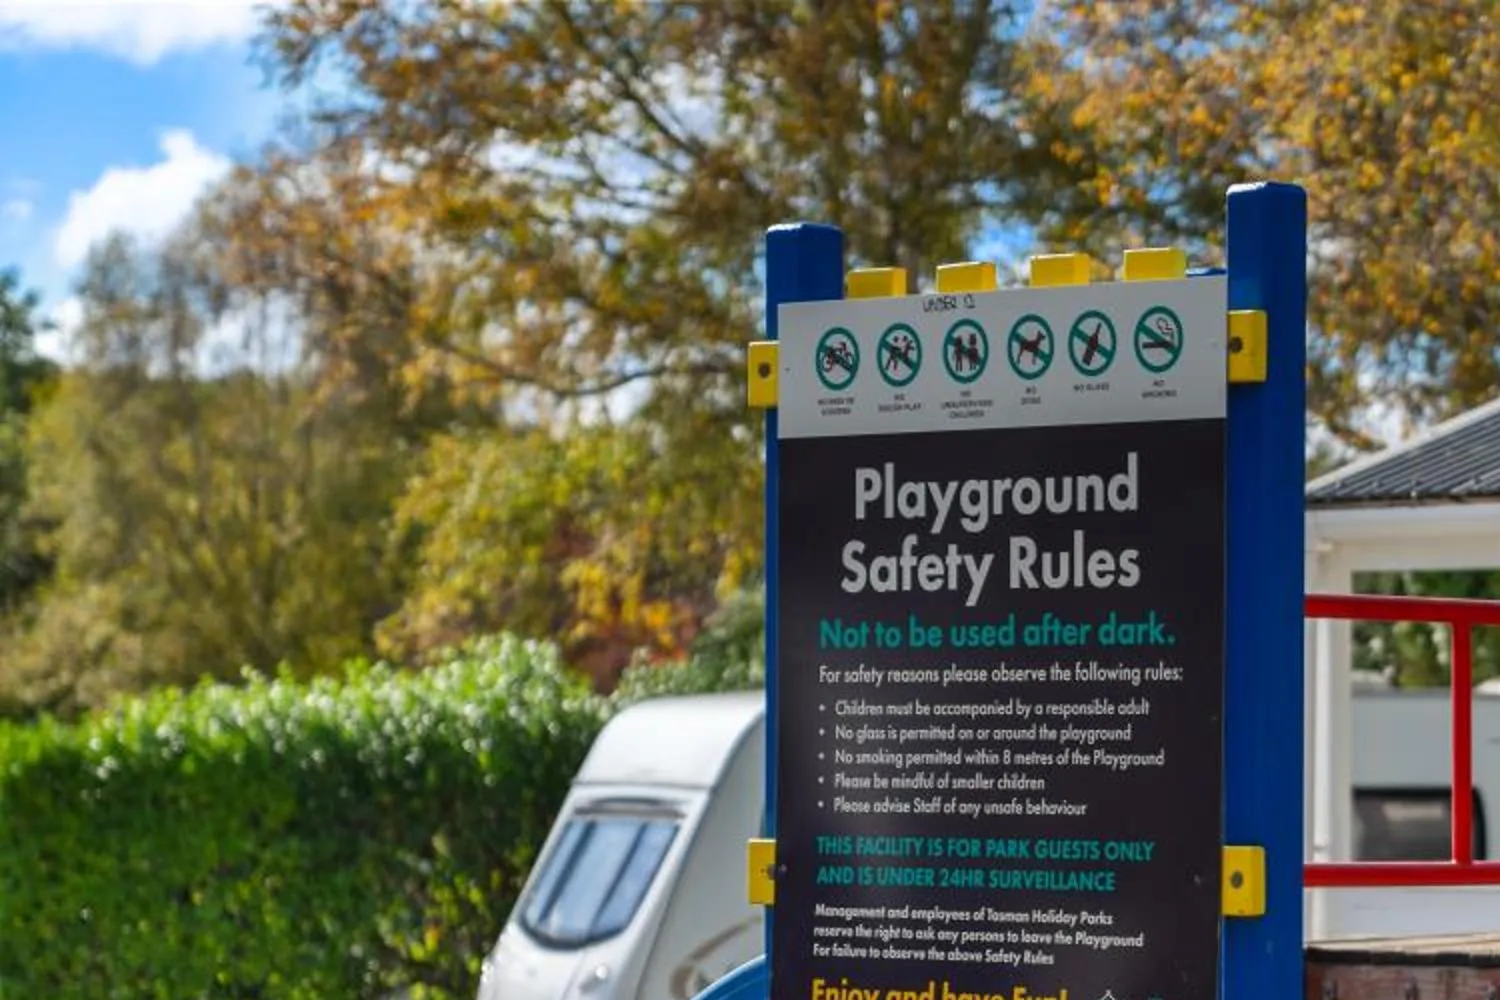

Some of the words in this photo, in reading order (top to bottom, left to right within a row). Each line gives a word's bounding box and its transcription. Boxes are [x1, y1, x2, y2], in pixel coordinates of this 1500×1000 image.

[855, 452, 1138, 534] Playground
[841, 534, 995, 606] Safety
[1009, 530, 1140, 588] Rules
[820, 617, 869, 648] Not
[874, 620, 901, 648] to
[909, 614, 944, 648] be
[949, 612, 1015, 648] used
[1023, 612, 1092, 647] after
[1098, 611, 1176, 646] dark.
[819, 665, 841, 683] For
[843, 663, 884, 688] safety
[888, 669, 939, 683] reasons
[943, 663, 988, 687] please
[991, 661, 1047, 683] observe
[1051, 662, 1072, 681] the
[1075, 661, 1141, 687] following
[1145, 660, 1183, 681] rules:
[835, 699, 883, 715] Children
[886, 701, 913, 715] must
[915, 699, 930, 715] be
[933, 697, 1013, 720] accompanied
[1016, 698, 1031, 719] by
[1034, 703, 1043, 715] a
[1046, 698, 1115, 719] responsible
[1118, 697, 1150, 715] adult
[835, 724, 853, 740] No
[856, 723, 886, 744] glass
[888, 725, 897, 740] is
[900, 723, 955, 744] permitted
[958, 728, 973, 740] on
[976, 728, 990, 740] or
[993, 724, 1036, 741] around
[1039, 723, 1057, 741] the
[1060, 723, 1131, 745] playground
[835, 749, 853, 764] No
[856, 747, 902, 768] smoking
[905, 747, 962, 768] permitted
[964, 748, 999, 765] within
[1003, 749, 1011, 765] 8
[1014, 751, 1053, 766] metres
[1056, 748, 1070, 766] of
[1072, 749, 1090, 766] the
[1093, 748, 1164, 771] Playground
[834, 771, 871, 789] Please
[873, 772, 888, 789] be
[891, 771, 934, 789] mindful
[937, 771, 949, 789] of
[952, 771, 994, 789] smaller
[997, 772, 1045, 790] children
[833, 796, 870, 813] Please
[873, 796, 910, 813] advise
[913, 796, 942, 813] Staff
[943, 796, 957, 814] of
[959, 802, 981, 819] any
[983, 797, 1022, 815] unsafe
[1025, 798, 1087, 815] behaviour
[816, 836, 853, 855] THIS
[856, 836, 925, 856] FACILITY
[928, 838, 944, 856] IS
[947, 838, 981, 858] FOR
[986, 839, 1029, 858] PARK
[1035, 839, 1100, 860] GUESTS
[1104, 841, 1155, 861] ONLY
[817, 866, 853, 885] AND
[857, 867, 874, 885] IS
[876, 867, 934, 887] UNDER
[939, 868, 984, 888] 24HR
[989, 870, 1116, 891] SURVEILLANCE
[814, 904, 885, 921] Management
[887, 905, 909, 919] and
[911, 905, 970, 924] employees
[973, 907, 985, 921] of
[987, 908, 1029, 922] Tasman
[1032, 909, 1078, 928] Holiday
[1080, 910, 1113, 925] Parks
[813, 926, 853, 938] reserve
[855, 924, 872, 938] the
[874, 924, 900, 942] right
[902, 927, 913, 939] to
[915, 926, 936, 940] ask
[938, 930, 959, 945] any
[961, 930, 1005, 946] persons
[1007, 930, 1019, 943] to
[1021, 929, 1053, 944] leave
[1054, 930, 1073, 945] the
[1075, 931, 1144, 950] Playground
[812, 943, 831, 957] For
[832, 943, 866, 958] failure
[869, 945, 880, 958] to
[882, 945, 925, 960] observe
[927, 946, 945, 961] the
[947, 948, 982, 963] above
[985, 949, 1021, 967] Safety
[1023, 949, 1054, 965] Rules
